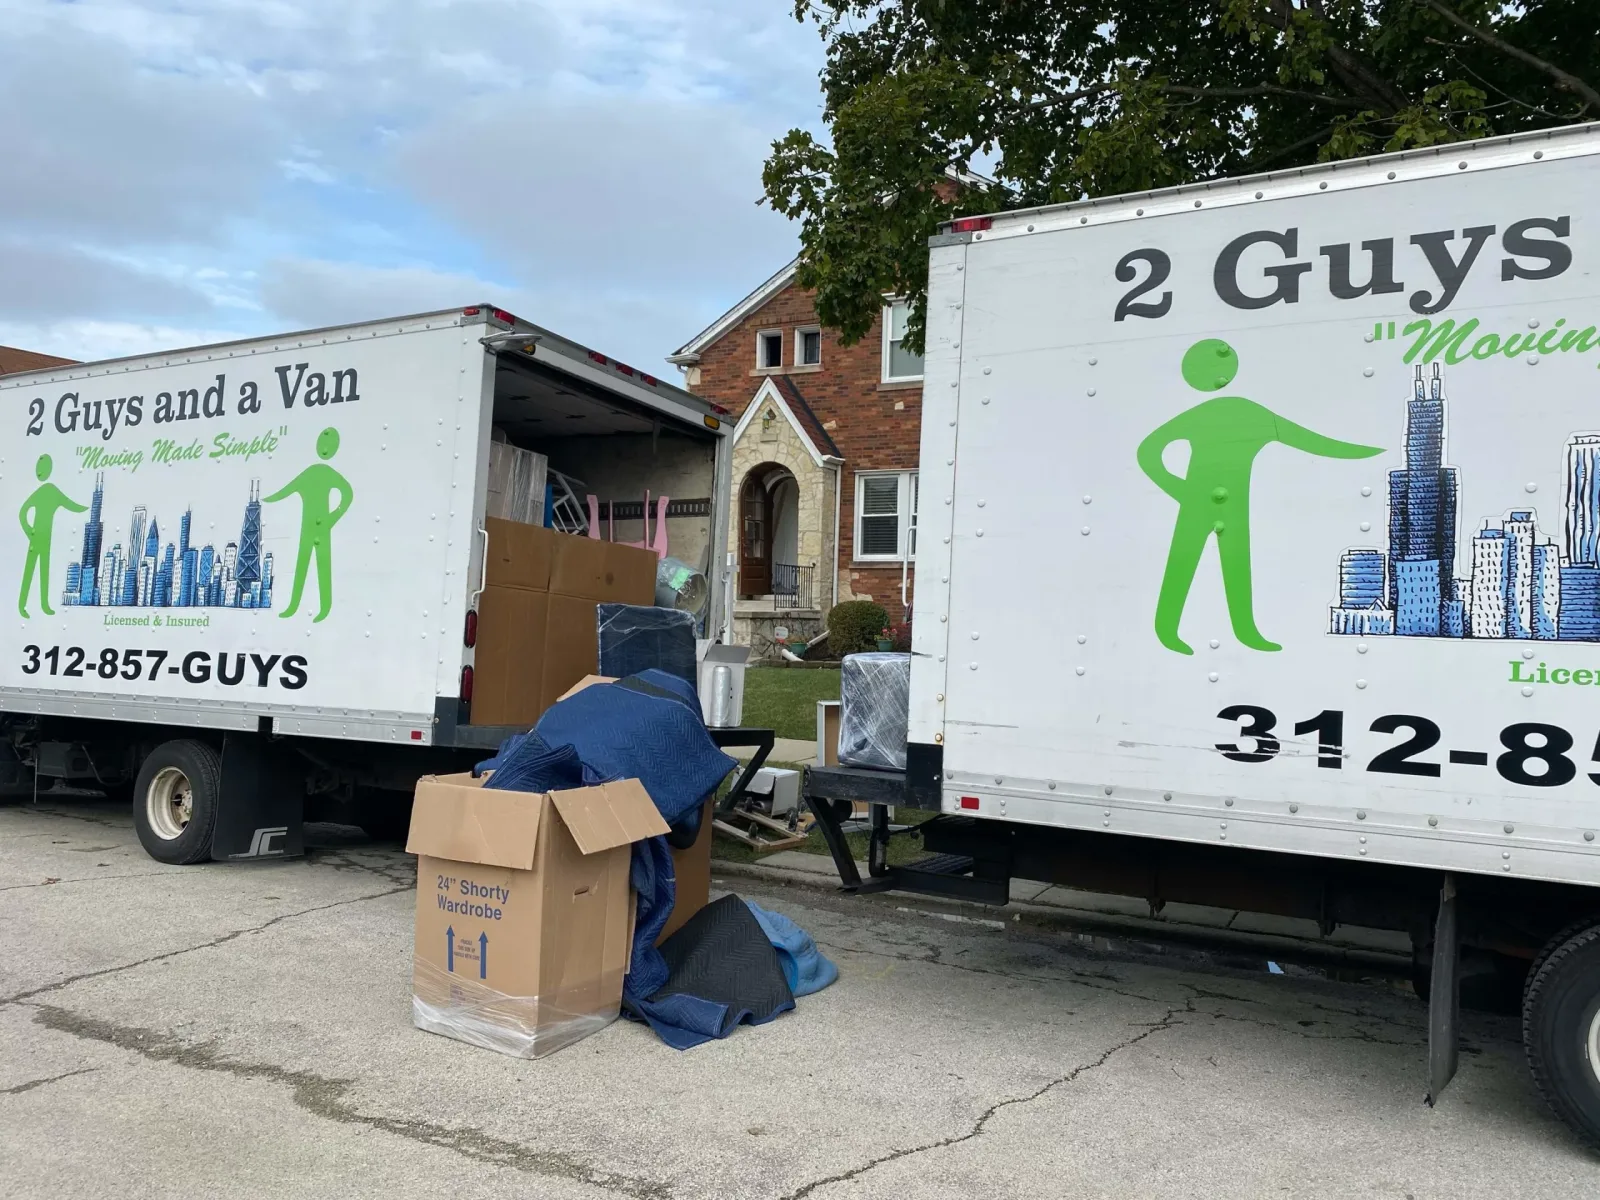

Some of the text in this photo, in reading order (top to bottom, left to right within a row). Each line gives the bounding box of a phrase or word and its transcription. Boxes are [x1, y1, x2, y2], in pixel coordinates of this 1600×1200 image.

[1114, 215, 1572, 322] 2 Guys
[1374, 318, 1600, 369] "Movin
[26, 362, 360, 441] 2 Guys and a Van
[76, 425, 287, 473] "Moving Made Simple"
[103, 614, 210, 627] Licensed & Insured
[21, 644, 309, 690] 312-857-GUYS
[1508, 661, 1600, 686] Lice
[1214, 704, 1600, 787] 312-8
[437, 893, 503, 921] Wardrobe
[460, 879, 510, 905] Shorty
